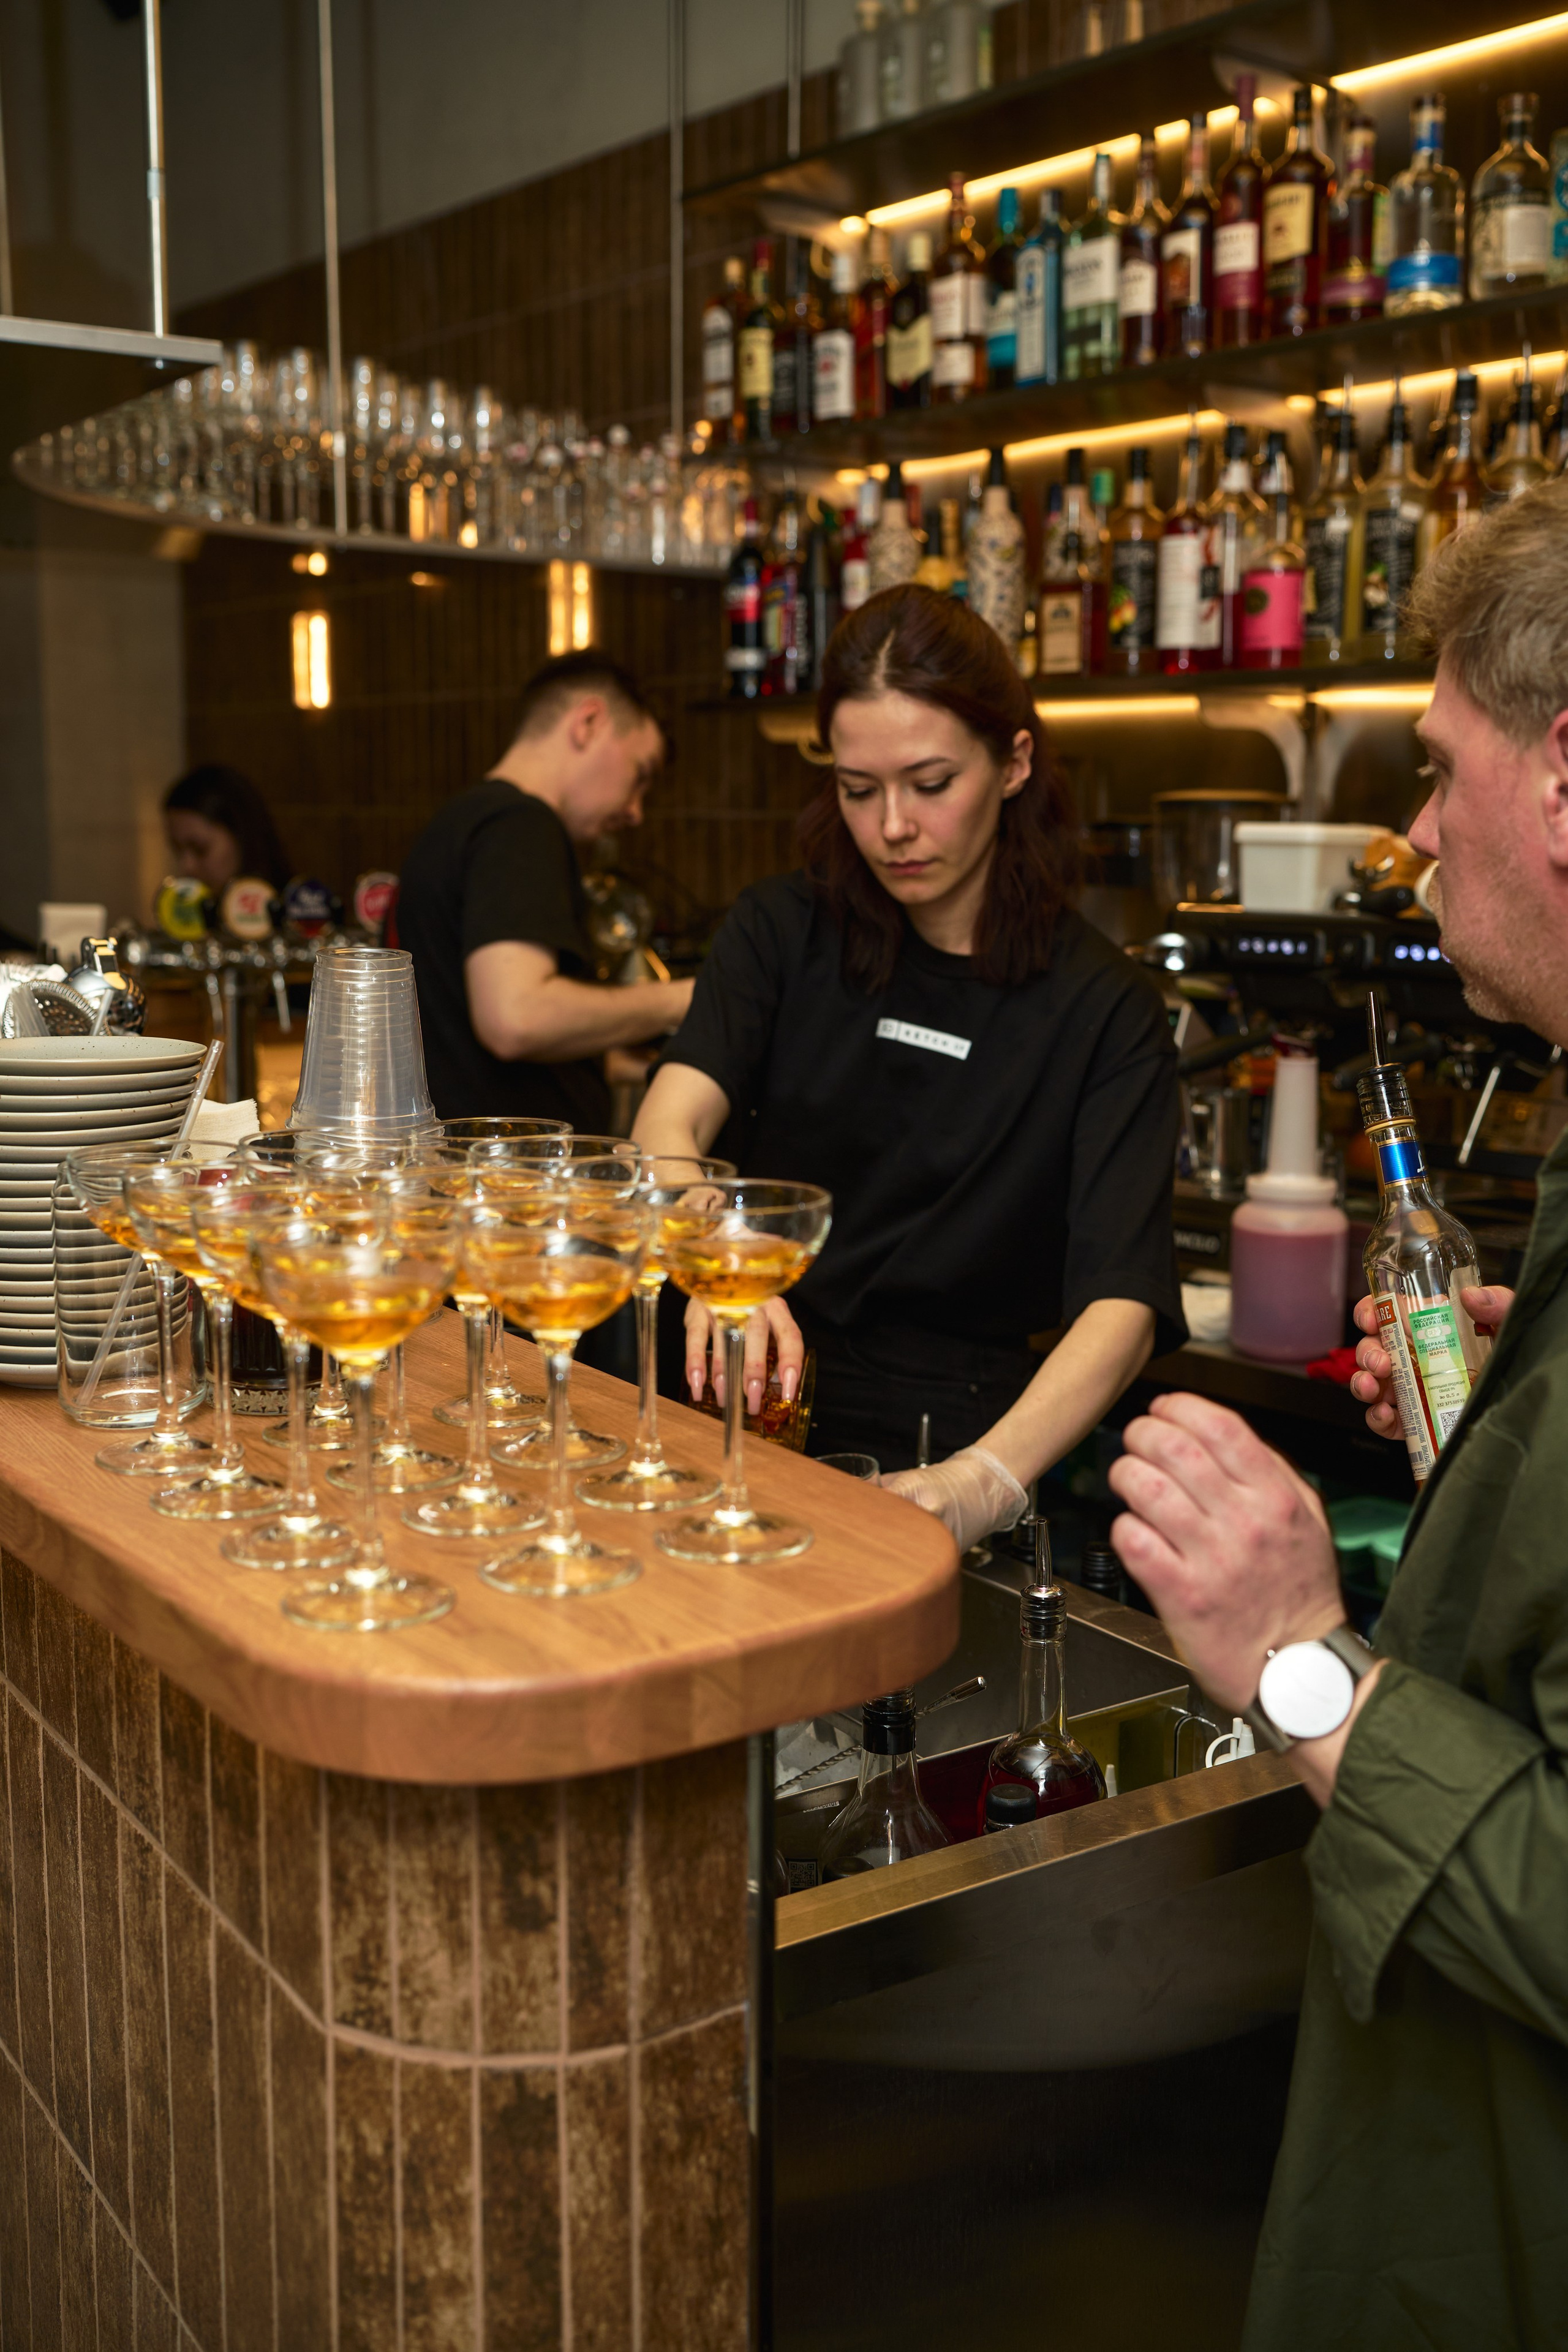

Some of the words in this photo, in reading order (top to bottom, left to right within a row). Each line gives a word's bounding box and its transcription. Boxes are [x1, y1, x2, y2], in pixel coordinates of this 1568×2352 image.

[1375, 1305, 1392, 1323] ARE
[1413, 1313, 1449, 1324] РОССИЙСКАЯ
[1414, 1317, 1449, 1329] ФЕДЕРАЦИЯ
[1392, 1323, 1403, 1348] ЗДОРОВЬЮ
[1418, 1338, 1455, 1349] ФЕДЕРАЛЬНАЯ
[1419, 1343, 1457, 1354] СПЕЦИАЛЬНАЯ
[1398, 1349, 1408, 1369] ВАШЕМУ
